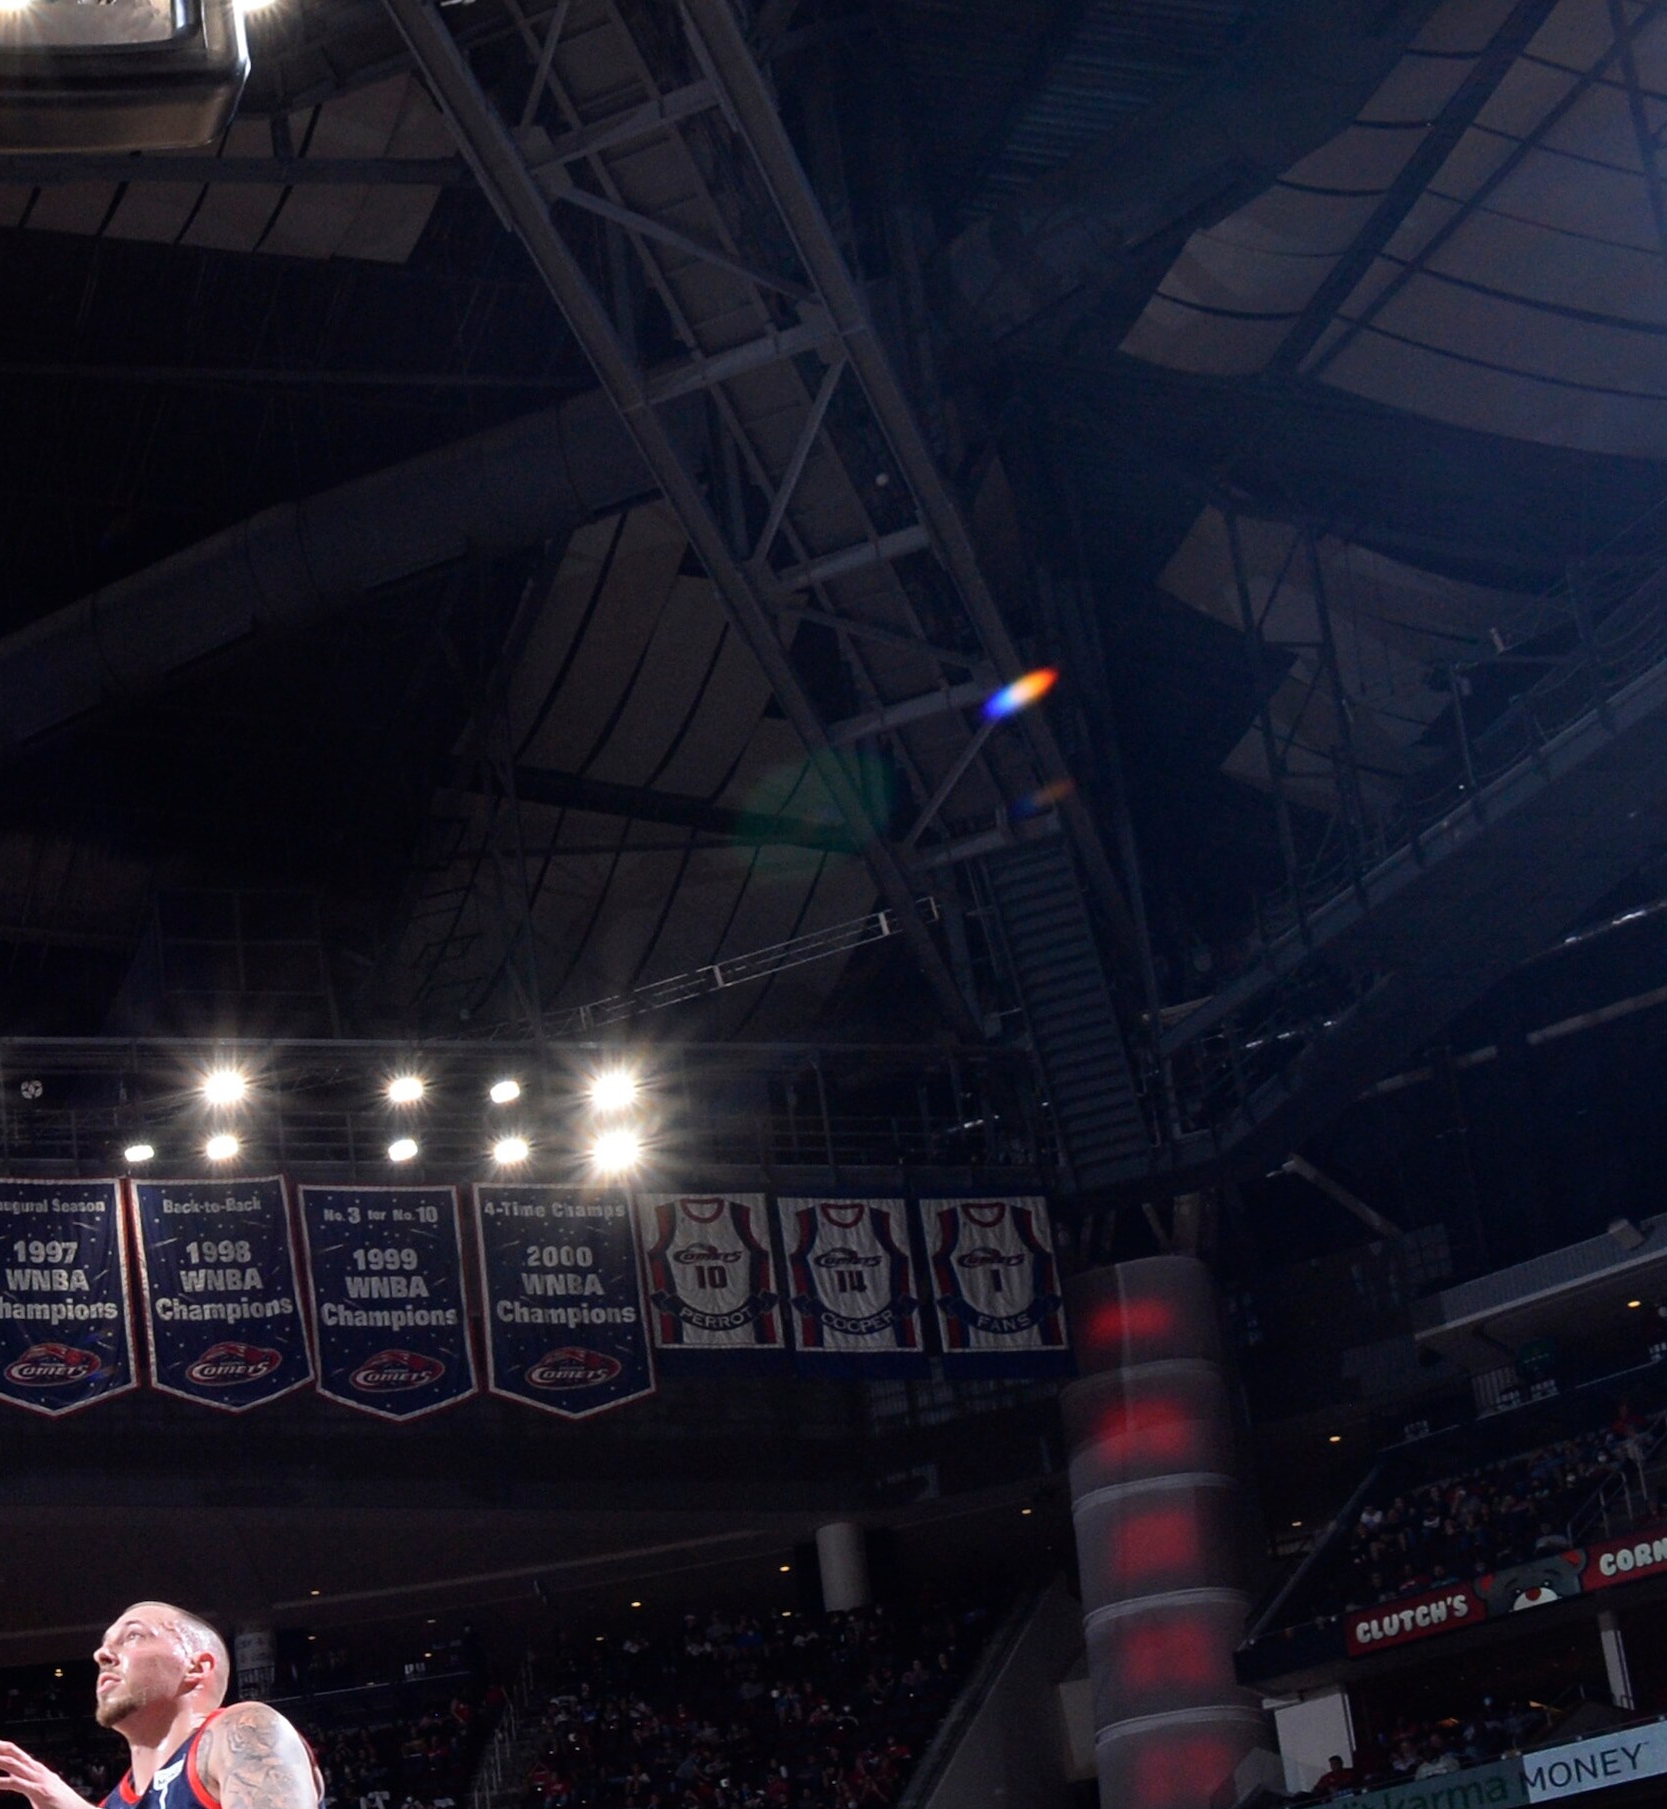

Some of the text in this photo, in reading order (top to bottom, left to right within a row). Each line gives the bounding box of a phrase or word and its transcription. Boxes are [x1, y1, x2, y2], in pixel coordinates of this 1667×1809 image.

[52, 1198, 105, 1213] Season
[163, 1197, 261, 1214] Back-to-Back
[348, 1207, 360, 1224] 3
[416, 1207, 438, 1223] 10
[484, 1202, 626, 1219] 4-Time Champs
[13, 1241, 78, 1264] 1997
[186, 1241, 251, 1264] 1998
[352, 1248, 418, 1271] 1999
[527, 1246, 593, 1268] 2000
[6, 1268, 90, 1292] WNBA
[180, 1268, 264, 1293] WNBA
[345, 1275, 429, 1298] WNBA
[522, 1273, 604, 1296] WNBA
[695, 1266, 727, 1289] 10
[835, 1270, 866, 1293] 14
[990, 1269, 1003, 1293] 1
[155, 1296, 294, 1325] Champions
[320, 1303, 458, 1331] Champions
[497, 1300, 637, 1329] Champions
[679, 1306, 752, 1328] PERROT
[821, 1309, 894, 1332] COOPER
[977, 1314, 1031, 1331] FANS
[1355, 1594, 1468, 1644] CLUTCH'S
[1522, 1744, 1643, 1798] MONEY
